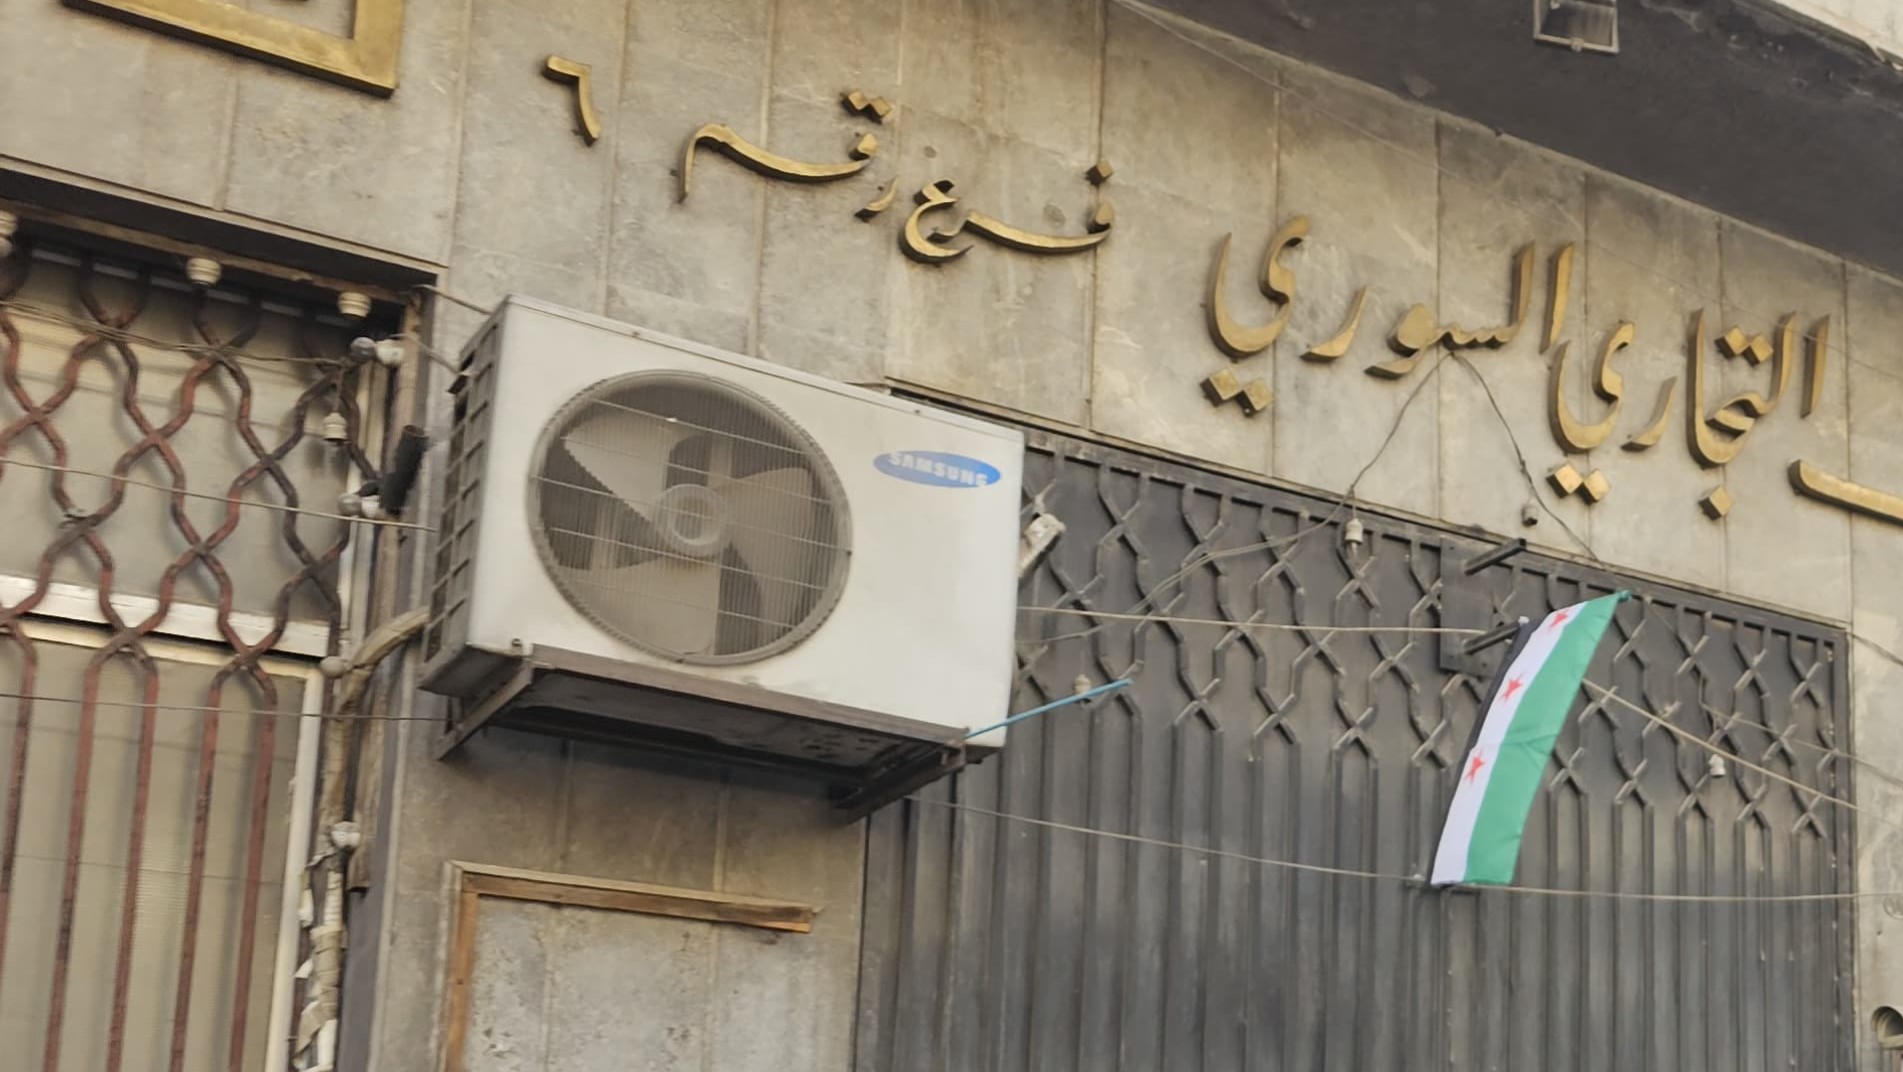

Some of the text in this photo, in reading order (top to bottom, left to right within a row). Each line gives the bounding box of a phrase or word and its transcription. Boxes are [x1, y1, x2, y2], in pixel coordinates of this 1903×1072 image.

[543, 54, 601, 147] ٦
[678, 90, 898, 222] رقم
[898, 160, 1115, 264] فرع
[1200, 214, 1574, 418] السوري
[888, 452, 988, 487] SAMSUNG
[1546, 307, 1830, 521] التجاري
